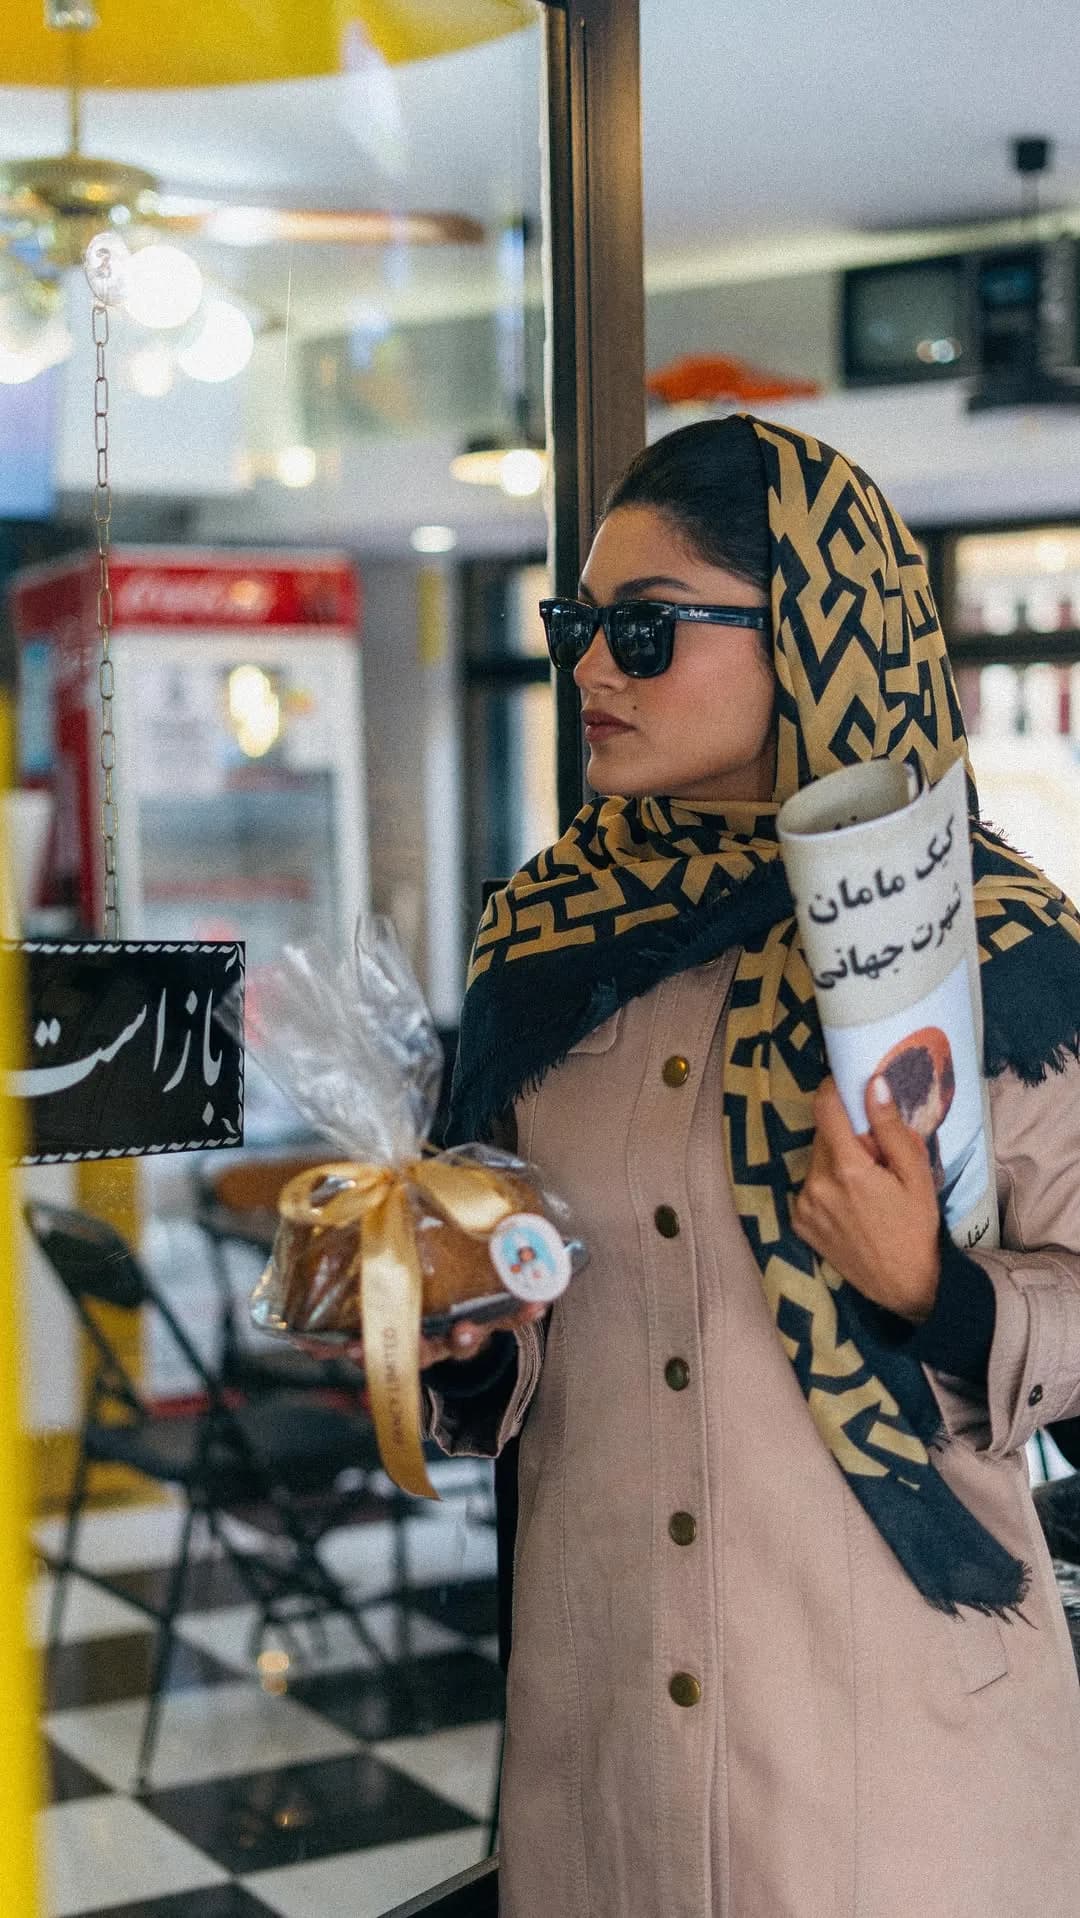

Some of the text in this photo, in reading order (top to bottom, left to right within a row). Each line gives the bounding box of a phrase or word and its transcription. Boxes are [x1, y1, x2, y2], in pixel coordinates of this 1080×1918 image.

[808, 812, 954, 924] کیک مامان
[812, 881, 961, 990] شهرت جهانی
[162, 988, 223, 1127] باز
[963, 1216, 990, 1249] سفا
